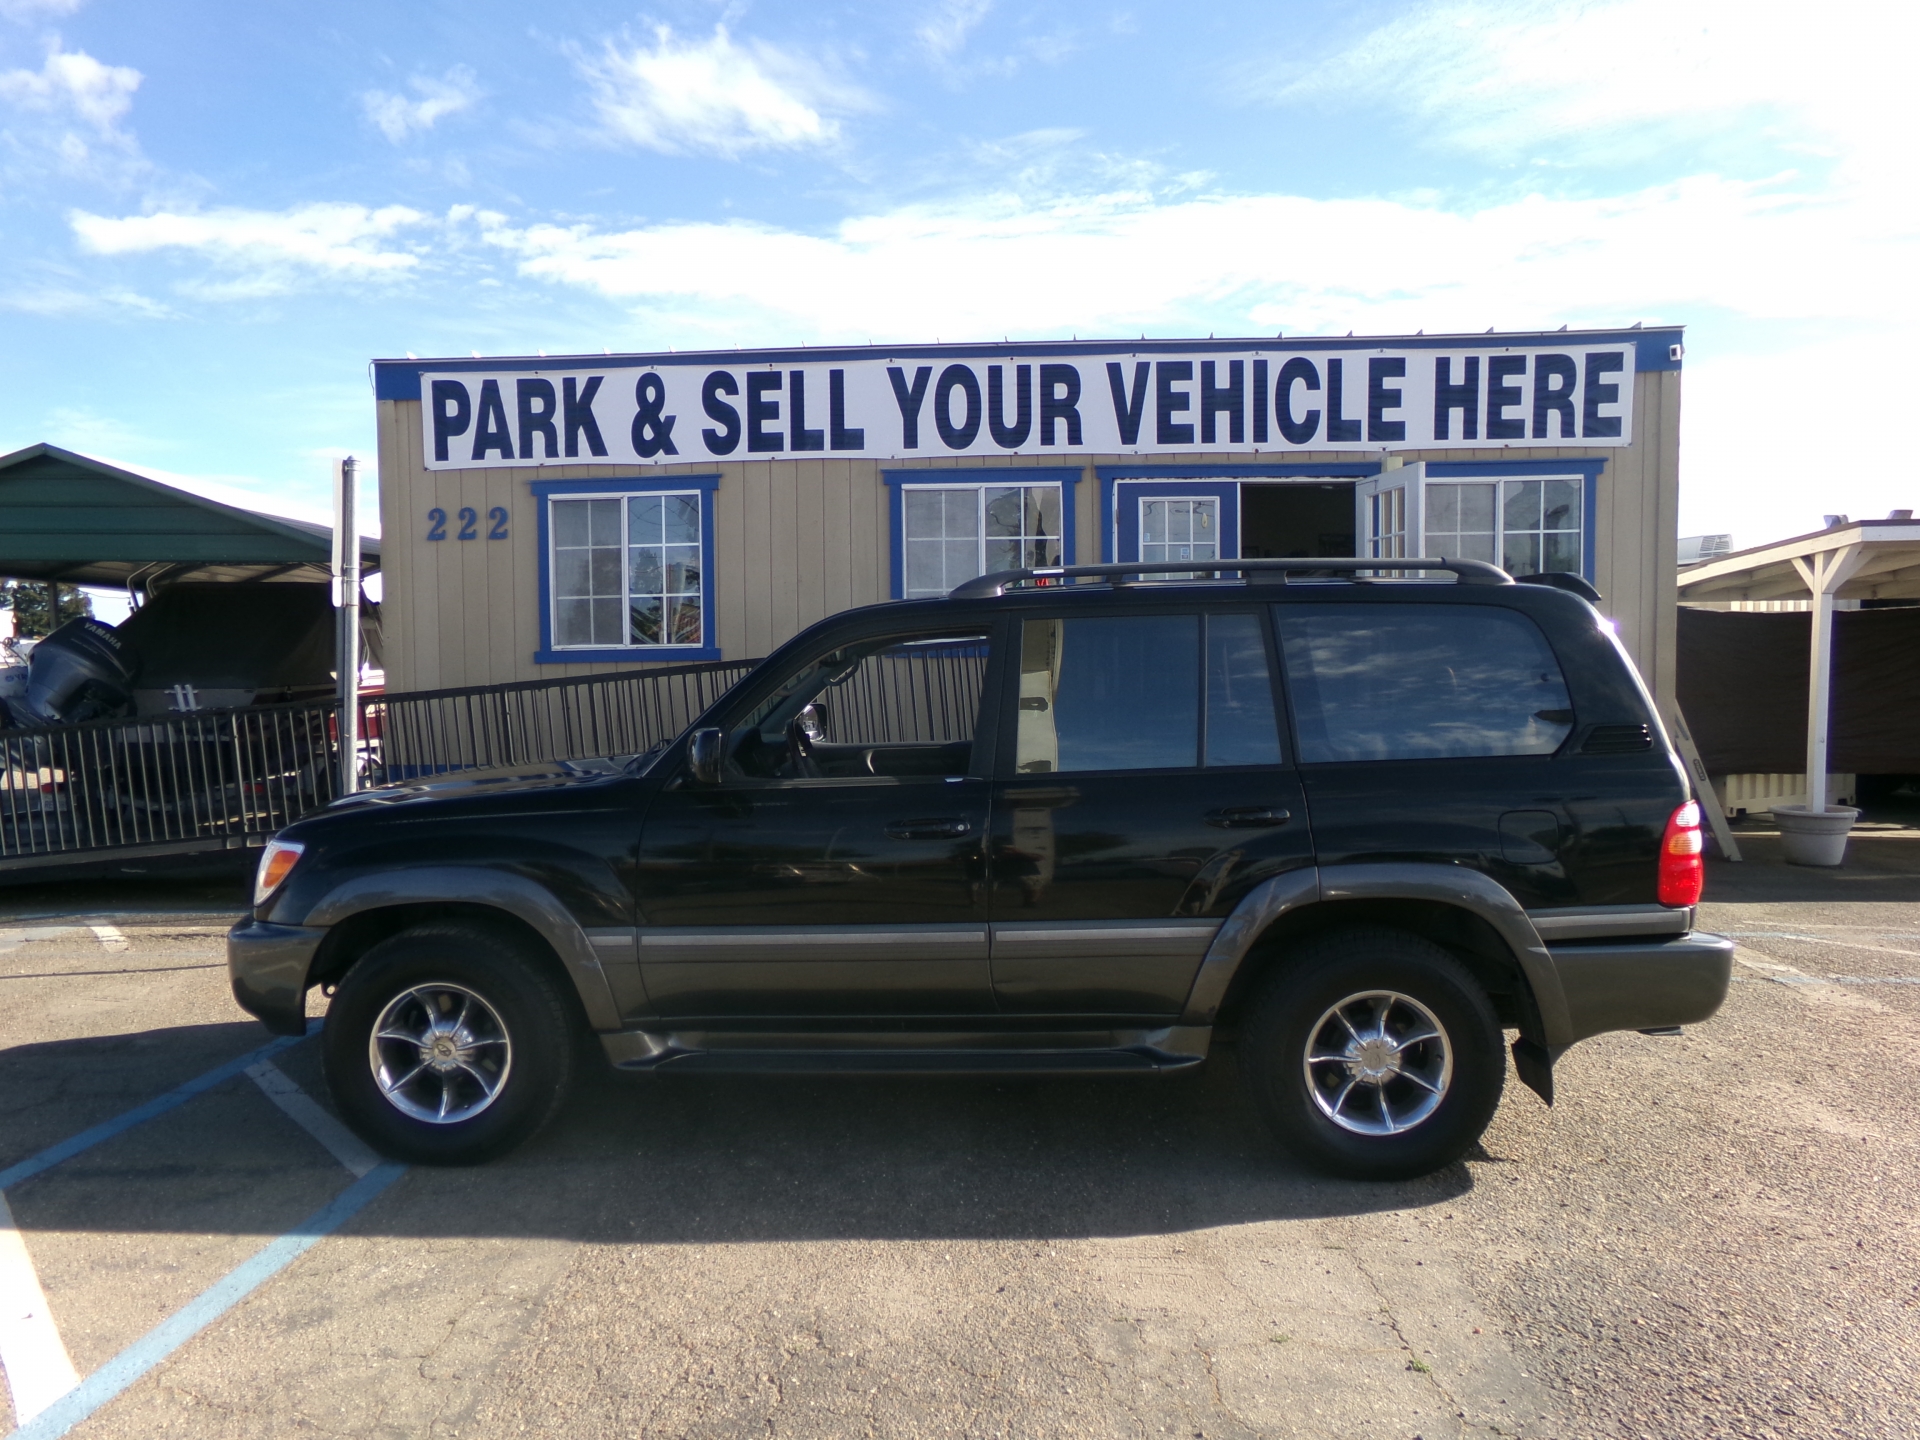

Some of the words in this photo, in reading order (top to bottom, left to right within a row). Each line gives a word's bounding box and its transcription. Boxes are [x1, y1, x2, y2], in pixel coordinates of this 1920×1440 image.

[432, 376, 608, 461] PARK
[632, 373, 679, 458] &
[702, 369, 864, 455] SELL
[887, 364, 1083, 449] YOUR
[1106, 357, 1405, 445] VEHICLE
[1434, 352, 1623, 440] HERE
[427, 506, 508, 541] 222
[84, 622, 122, 650] YAMAHA
